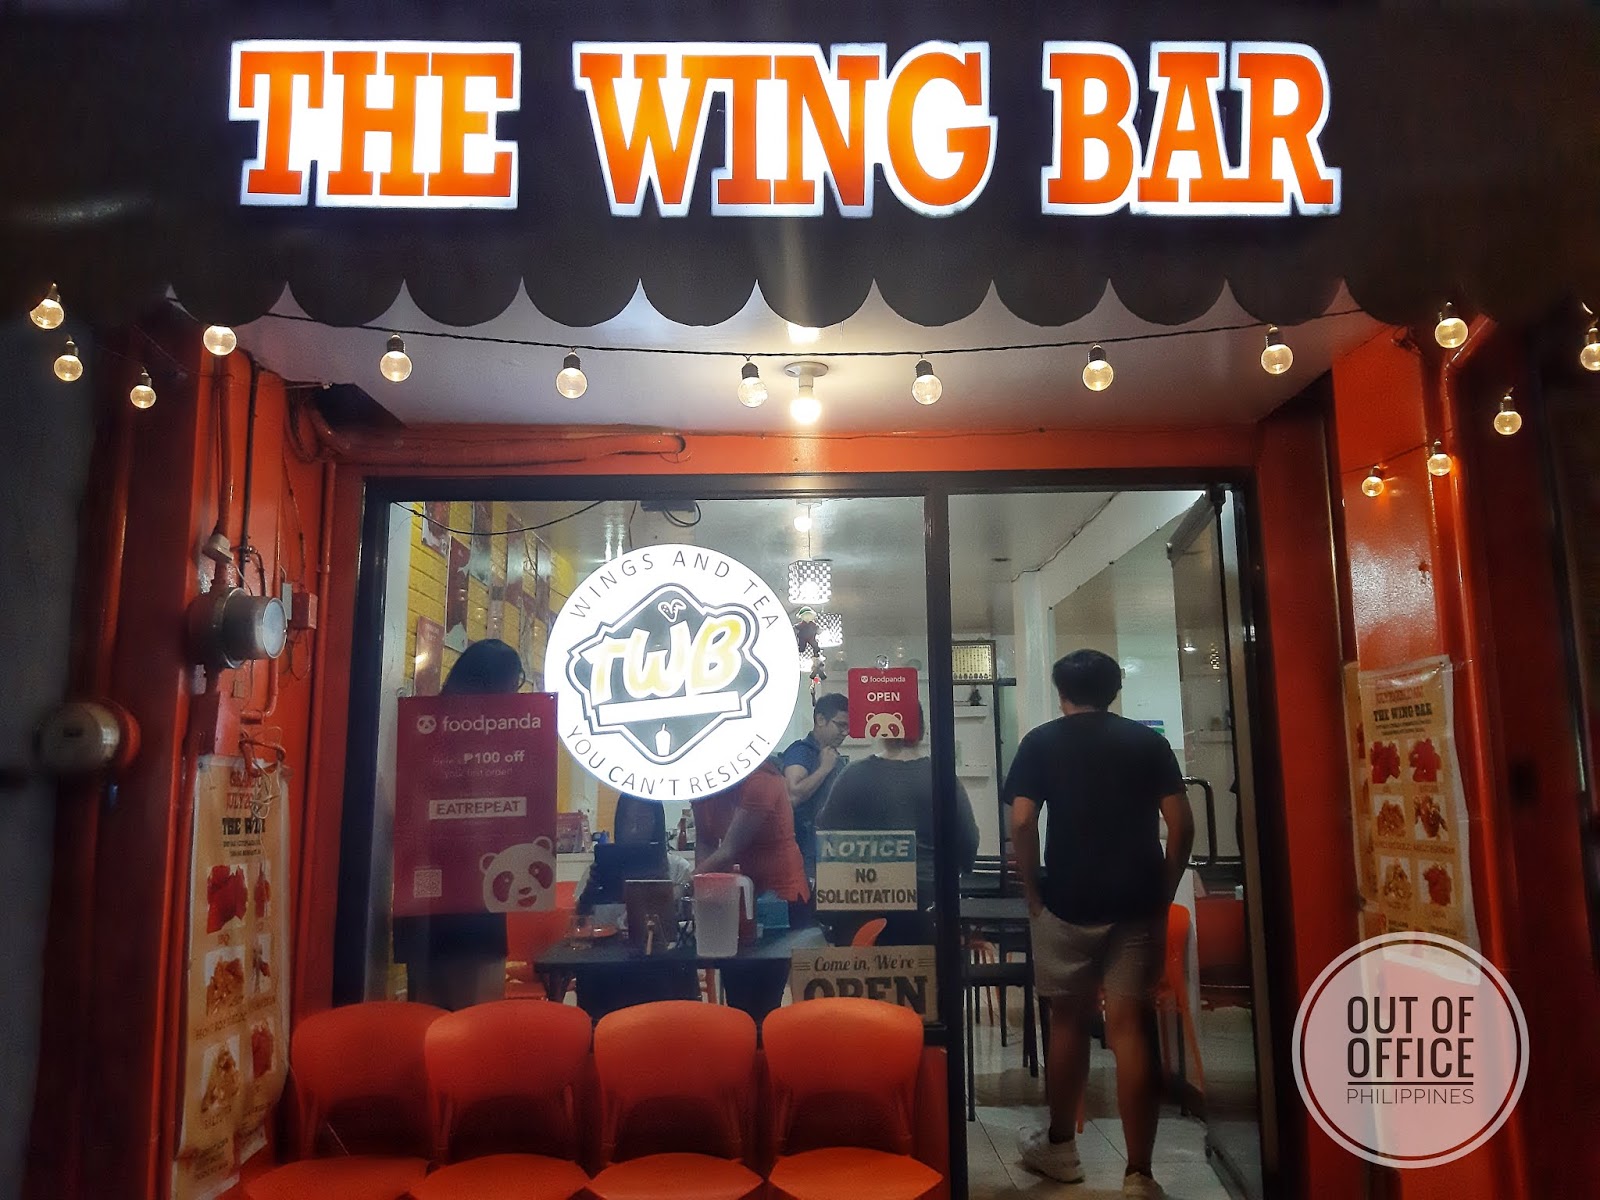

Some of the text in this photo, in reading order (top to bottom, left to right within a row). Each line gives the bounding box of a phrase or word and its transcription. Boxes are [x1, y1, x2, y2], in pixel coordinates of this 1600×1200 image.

[229, 41, 1341, 217] THE WING BAR
[570, 551, 779, 630] WINGS AND TEA
[580, 614, 743, 706] TWB
[869, 675, 906, 683] foodpanda
[867, 692, 900, 702] OPEN
[442, 712, 541, 735] foodpanda
[505, 750, 525, 763] off
[566, 725, 771, 796] YOU CAN'T RESIST!
[437, 801, 521, 815] EATREPEAT
[821, 840, 910, 857] NOTICE
[856, 868, 877, 883] NO
[817, 889, 916, 904] SOLICITATION
[814, 954, 914, 972] Come in, We're
